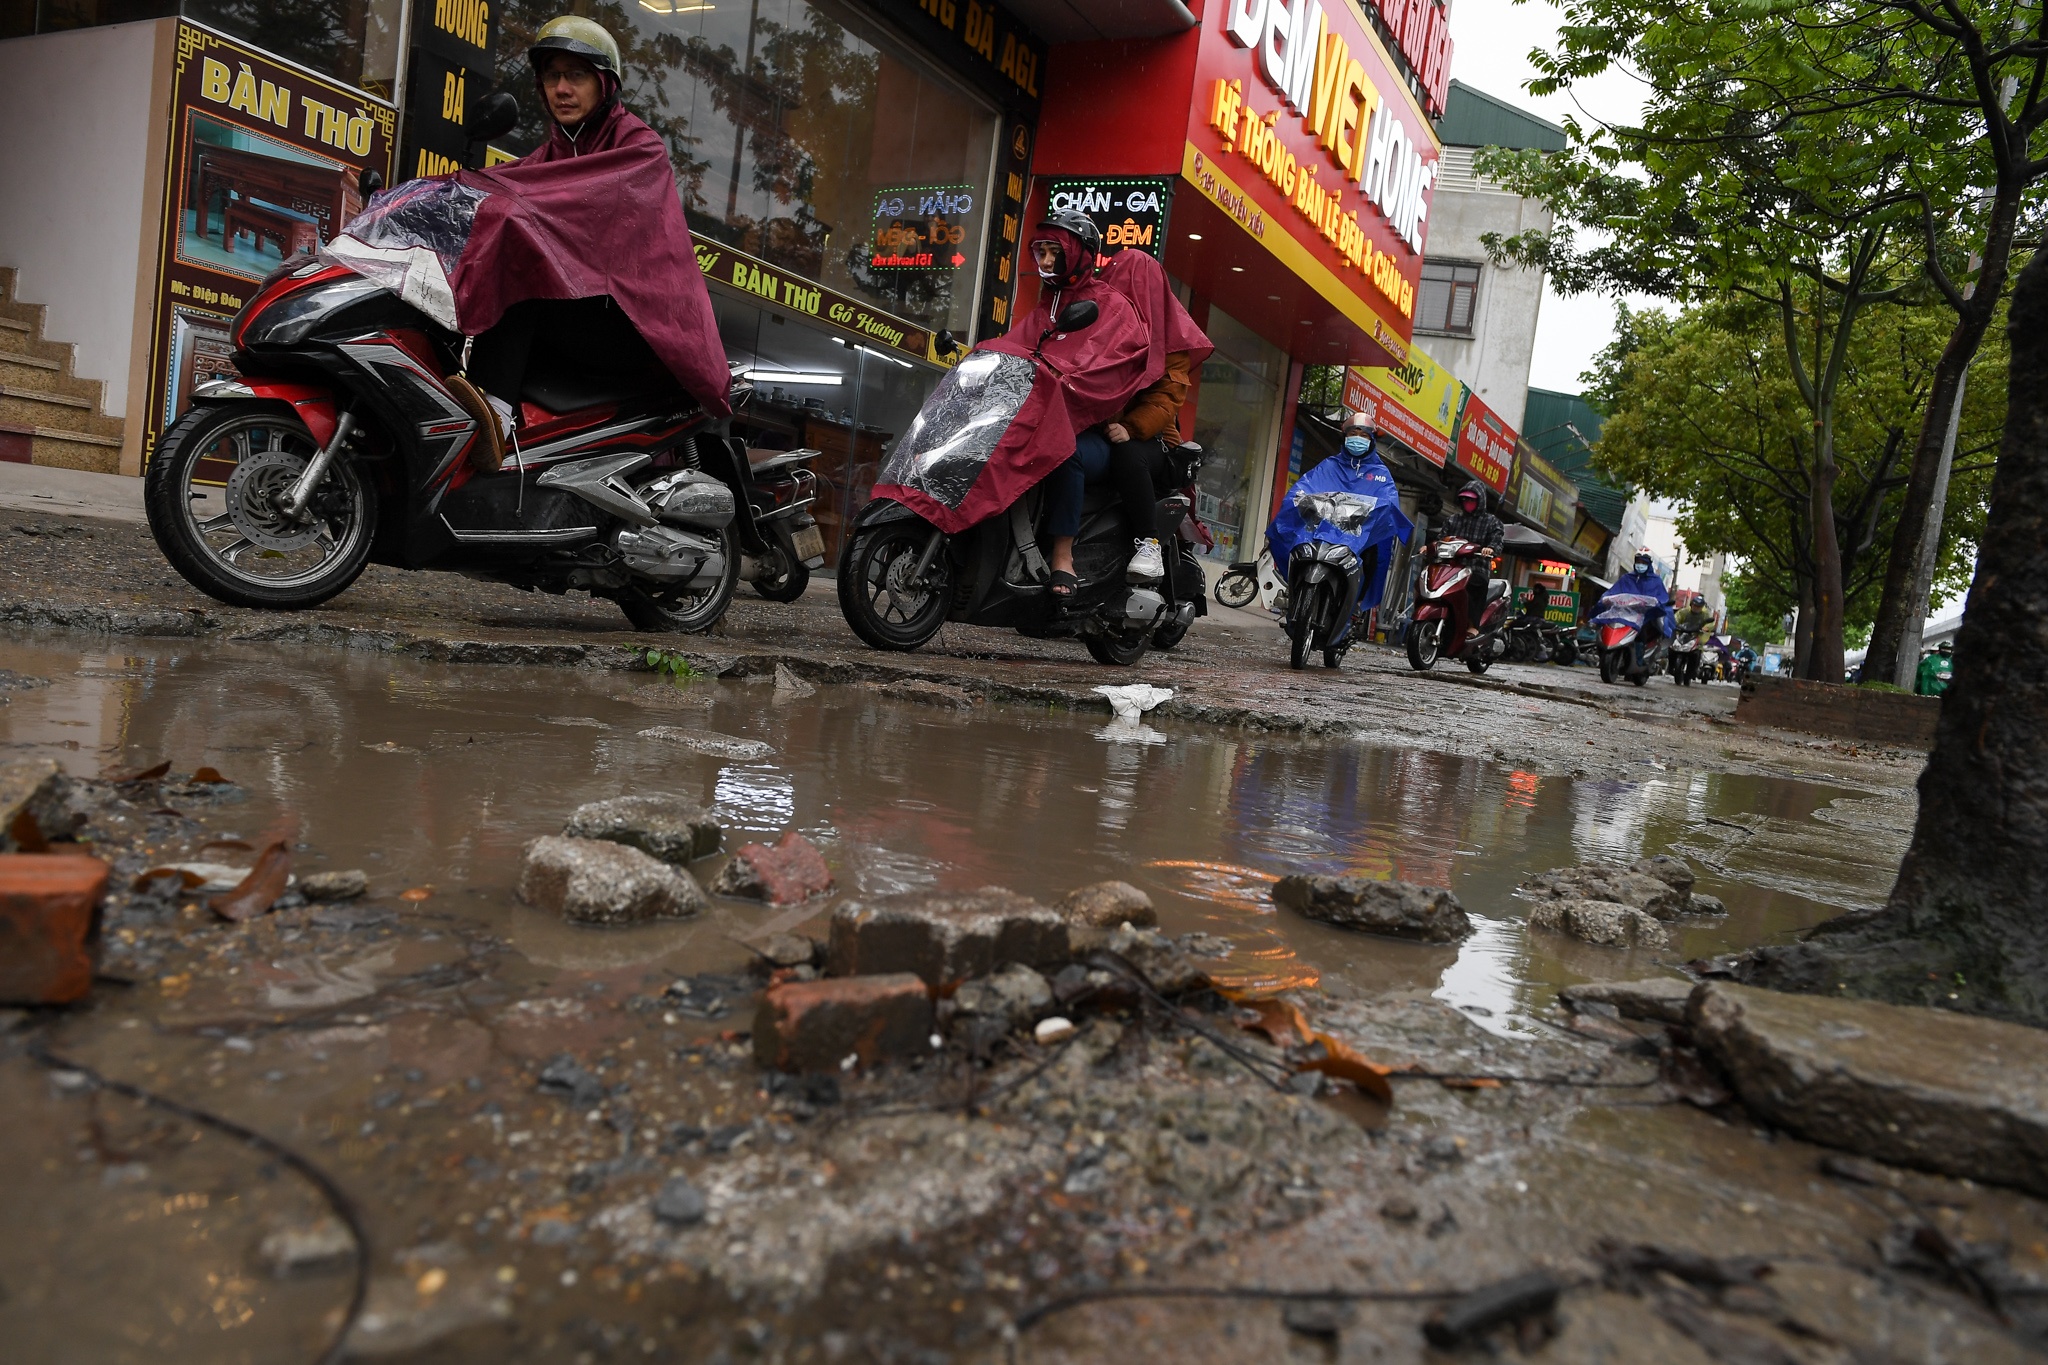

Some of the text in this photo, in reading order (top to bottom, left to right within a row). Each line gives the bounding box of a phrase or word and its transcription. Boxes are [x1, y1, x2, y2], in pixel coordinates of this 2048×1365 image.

[442, 67, 465, 126] ĐÁ
[1000, 32, 1038, 98] AGL
[201, 56, 374, 157] BÀN THỜ
[1052, 187, 1111, 212] CHĂN
[1126, 191, 1160, 213] GA
[1211, 78, 1241, 153] HỆ
[1239, 105, 1297, 197] THỐNG
[1293, 163, 1327, 227] BÁN
[1335, 209, 1365, 267] ĐỆM
[1400, 279, 1414, 319] GA
[170, 279, 191, 297] Mr:
[732, 261, 778, 299] BÀN
[784, 281, 822, 315] THỜ
[829, 302, 856, 323] Gỗ
[856, 312, 904, 347] Hương
